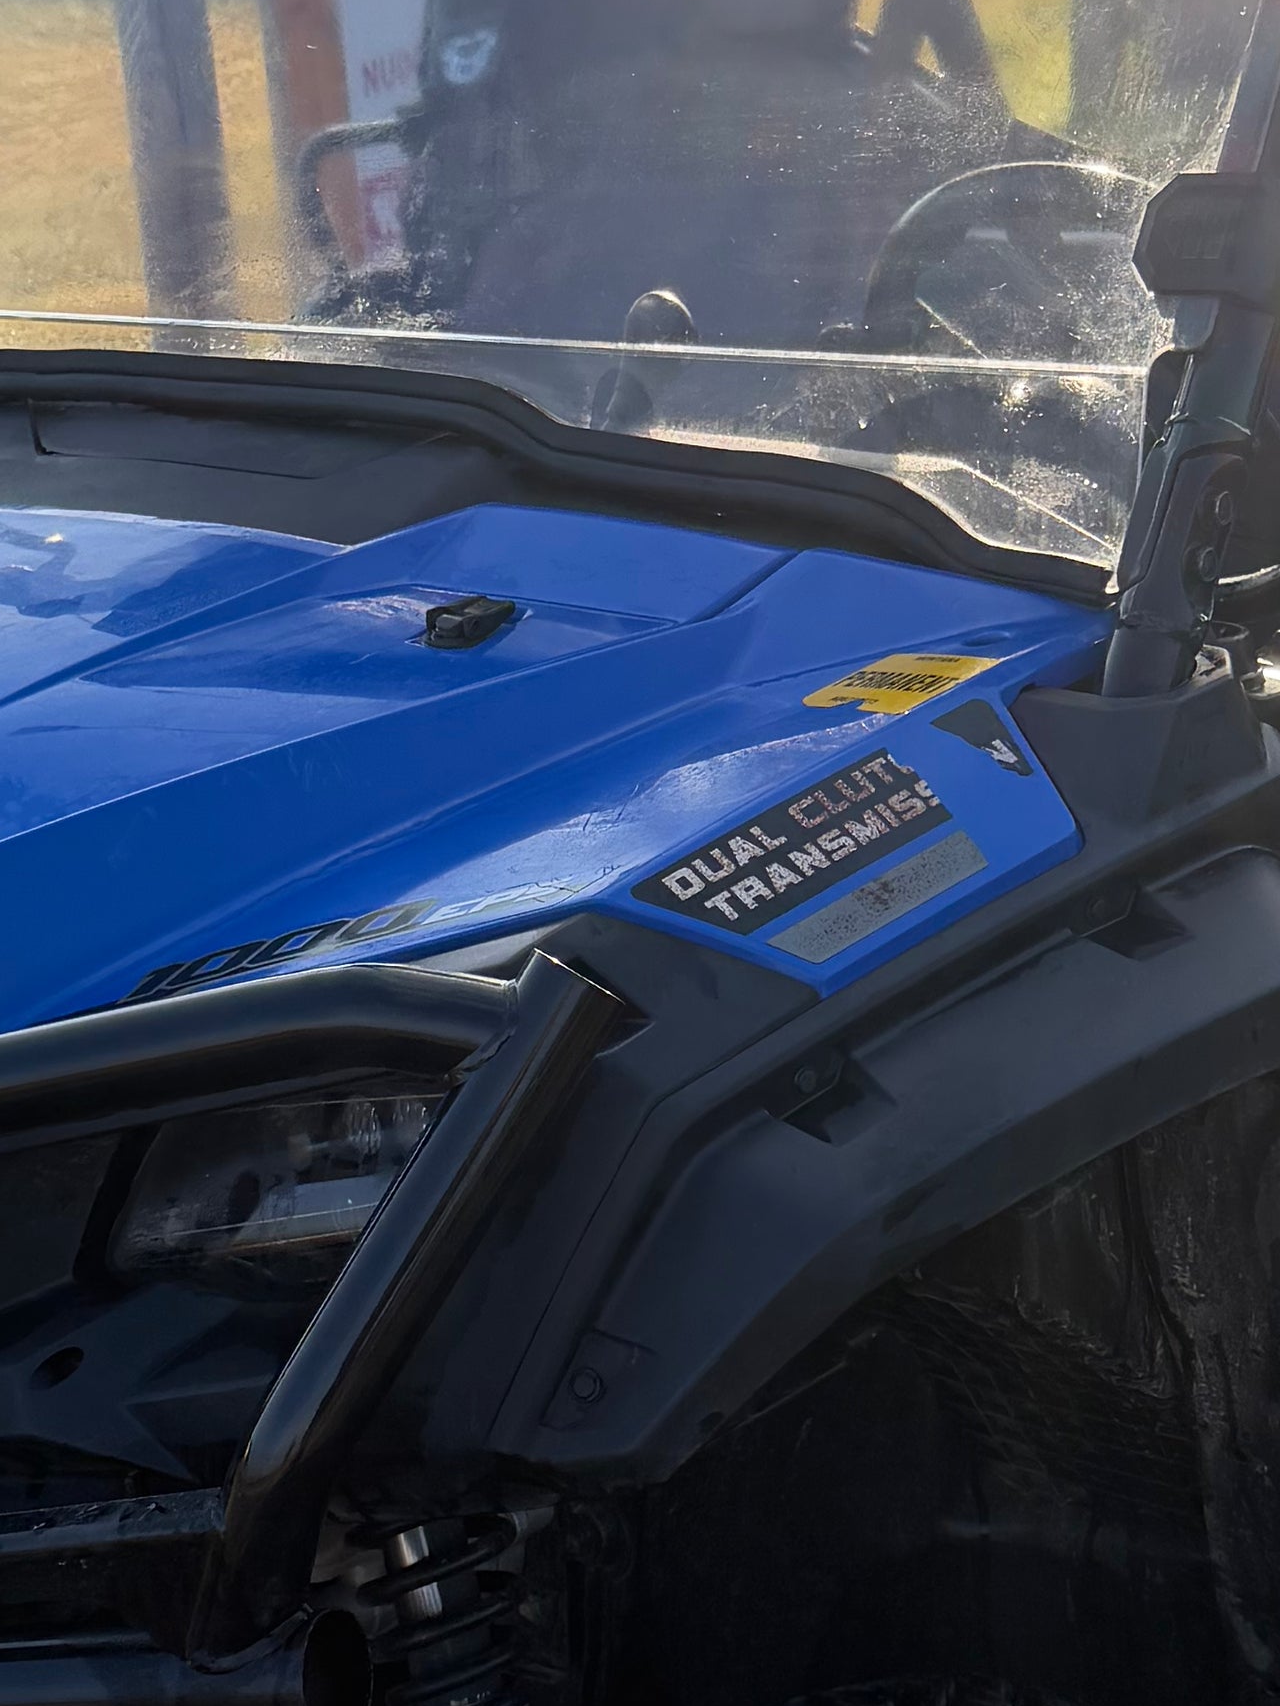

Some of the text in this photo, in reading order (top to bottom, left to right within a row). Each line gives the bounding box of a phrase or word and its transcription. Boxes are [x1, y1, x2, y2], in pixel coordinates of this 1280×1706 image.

[835, 670, 960, 694] PERMANENT
[661, 753, 915, 901] DUAL CLUT
[122, 897, 437, 1004] 1000
